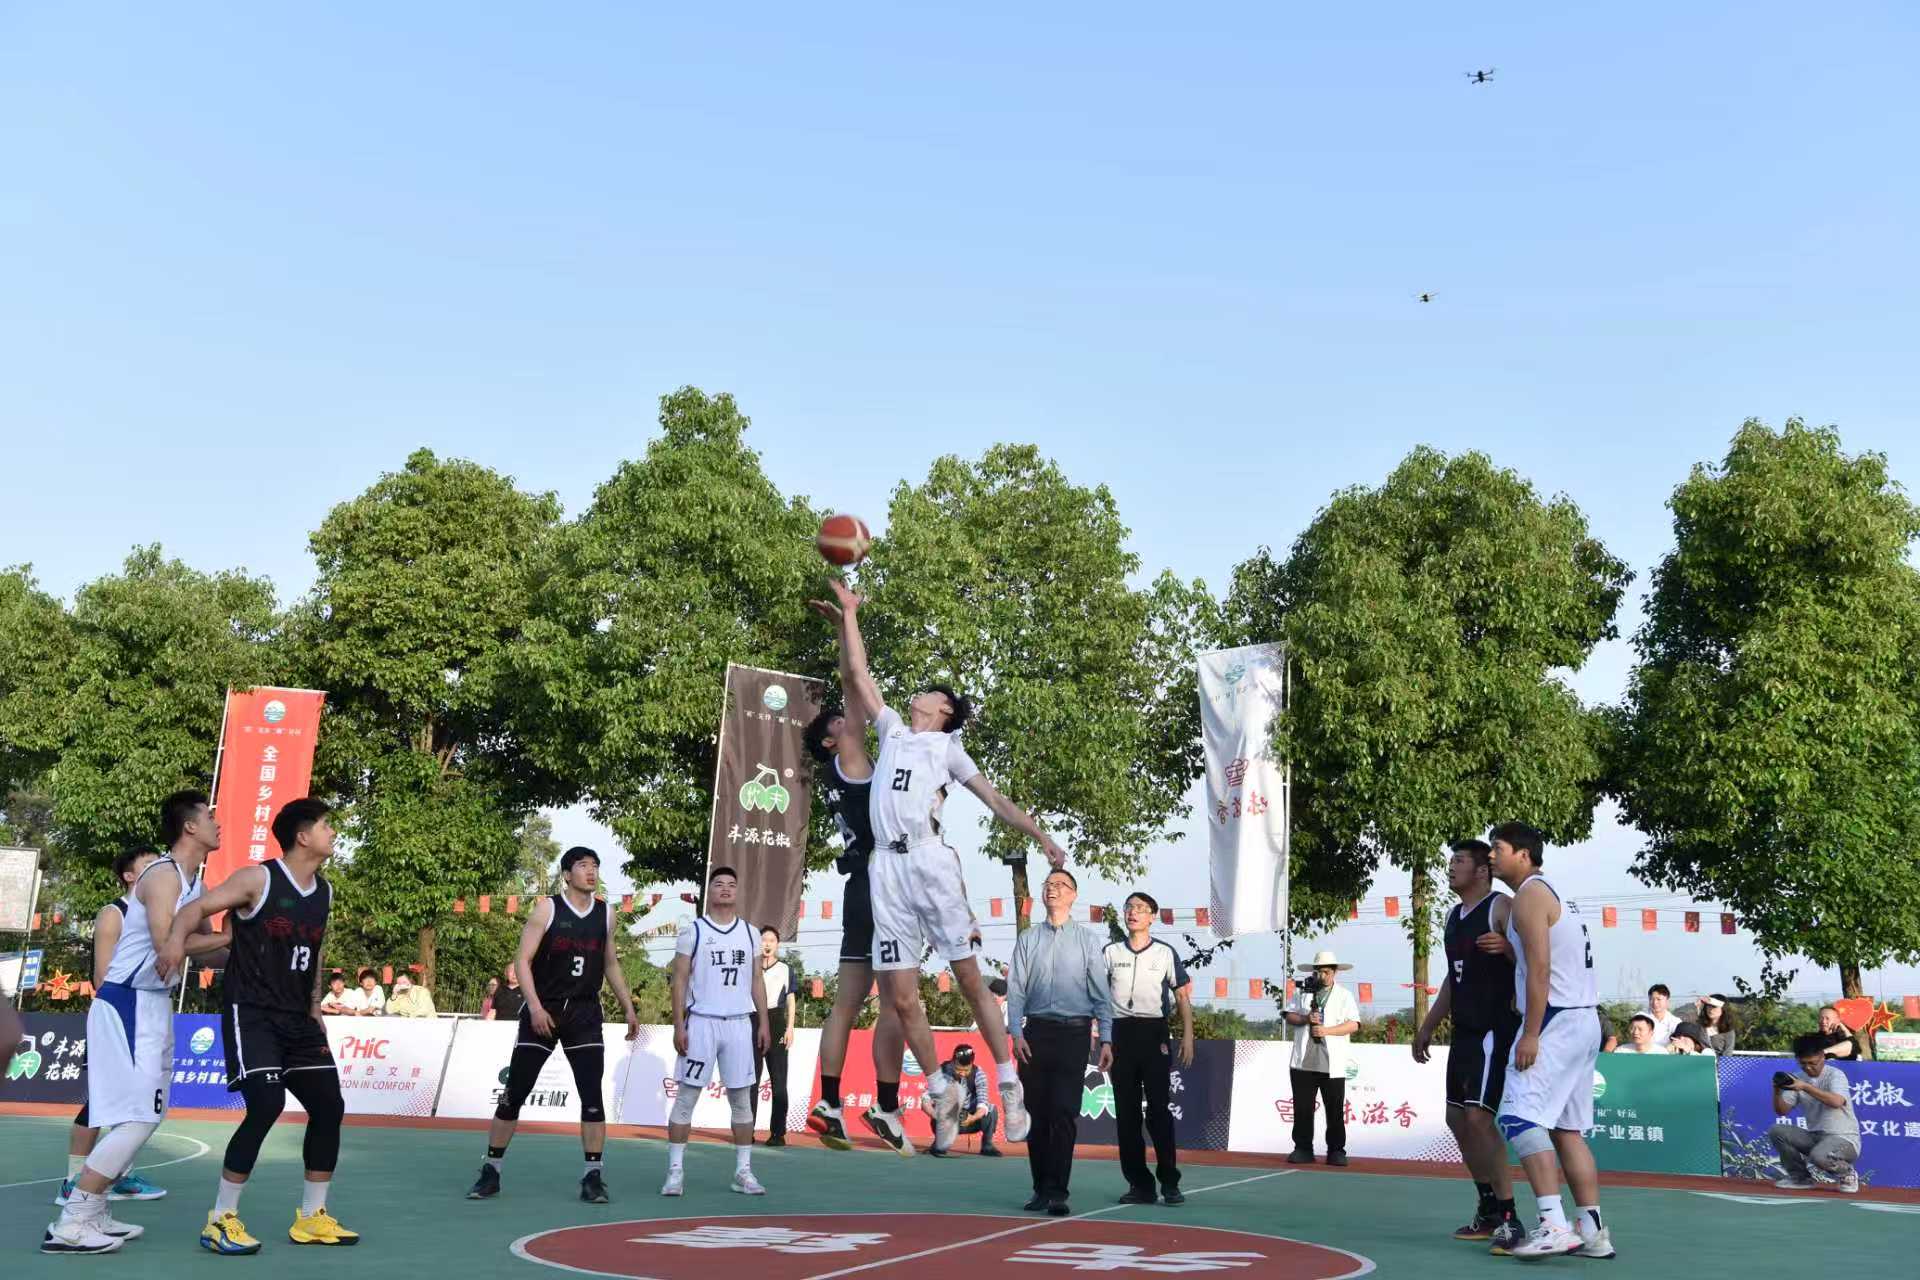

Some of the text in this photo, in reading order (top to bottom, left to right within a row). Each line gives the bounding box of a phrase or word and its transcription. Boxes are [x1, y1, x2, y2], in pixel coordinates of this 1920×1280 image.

[892, 768, 912, 792] 21
[247, 745, 280, 861] 全国乡村治理
[290, 945, 311, 972] 13
[711, 949, 746, 966] 江津
[879, 939, 901, 963] 21
[571, 955, 585, 977] 3
[721, 967, 738, 987] 77
[170, 1070, 228, 1085] 美乡村重点
[685, 1059, 705, 1080] 77
[360, 1079, 370, 1089] IN
[372, 1080, 417, 1091] COMFORT
[1848, 1079, 1915, 1108] 花椒
[153, 1088, 163, 1114] 6
